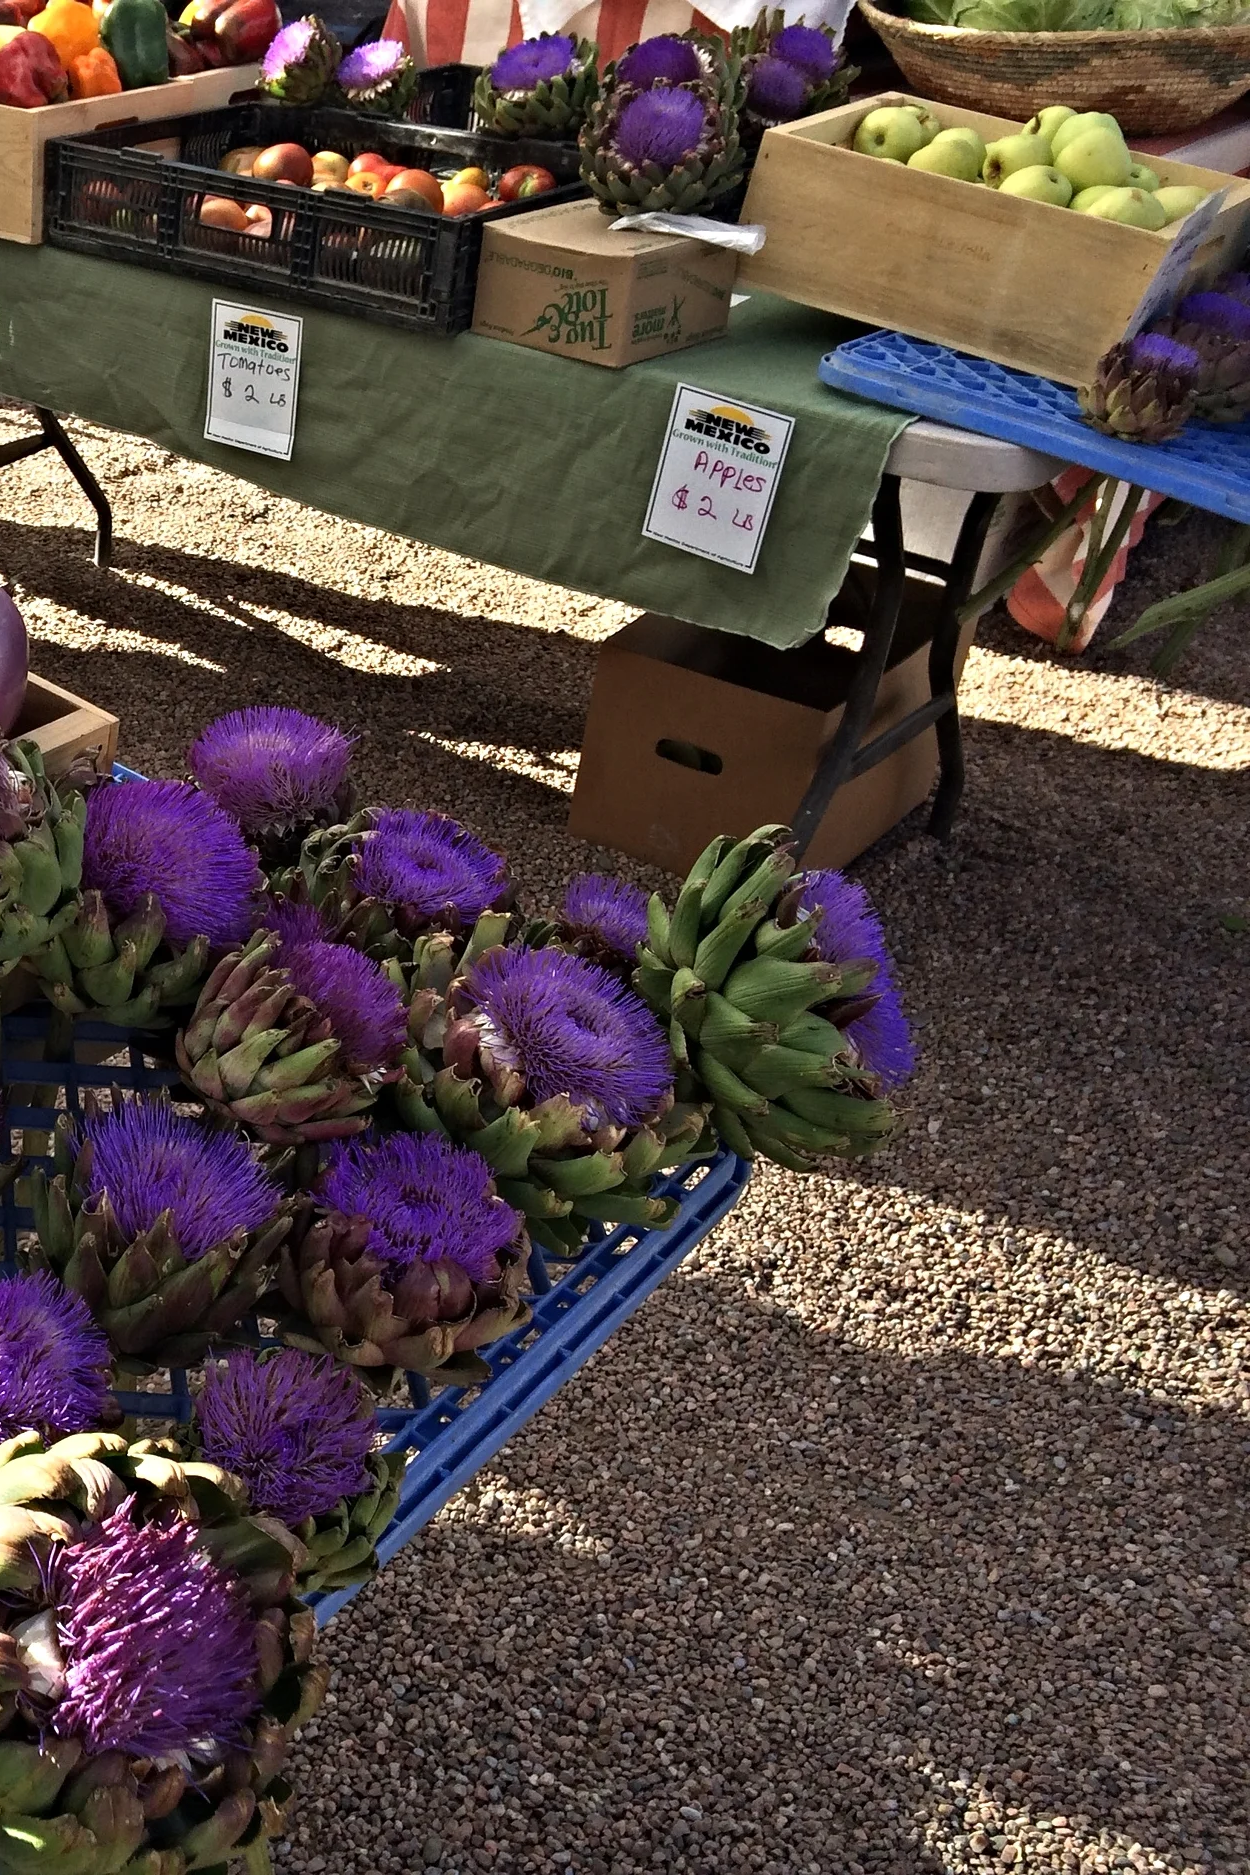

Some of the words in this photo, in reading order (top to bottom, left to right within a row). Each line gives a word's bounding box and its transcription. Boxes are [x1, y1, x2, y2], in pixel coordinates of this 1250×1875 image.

[561, 288, 613, 320] Tote
[223, 329, 289, 353] MEXICO
[237, 322, 276, 339] NEW
[565, 313, 613, 350] Tug
[215, 340, 240, 352] Grown
[241, 346, 259, 357] with
[260, 350, 296, 364] Tradition
[222, 377, 232, 398] $
[244, 384, 260, 404] 2
[684, 418, 770, 454] MEXICO
[705, 412, 754, 437] NEW
[672, 428, 704, 446] Grown
[706, 440, 729, 453] with
[730, 446, 777, 469] Tradition
[672, 484, 689, 510] $
[697, 496, 717, 520] 2
[732, 508, 754, 531] LB
